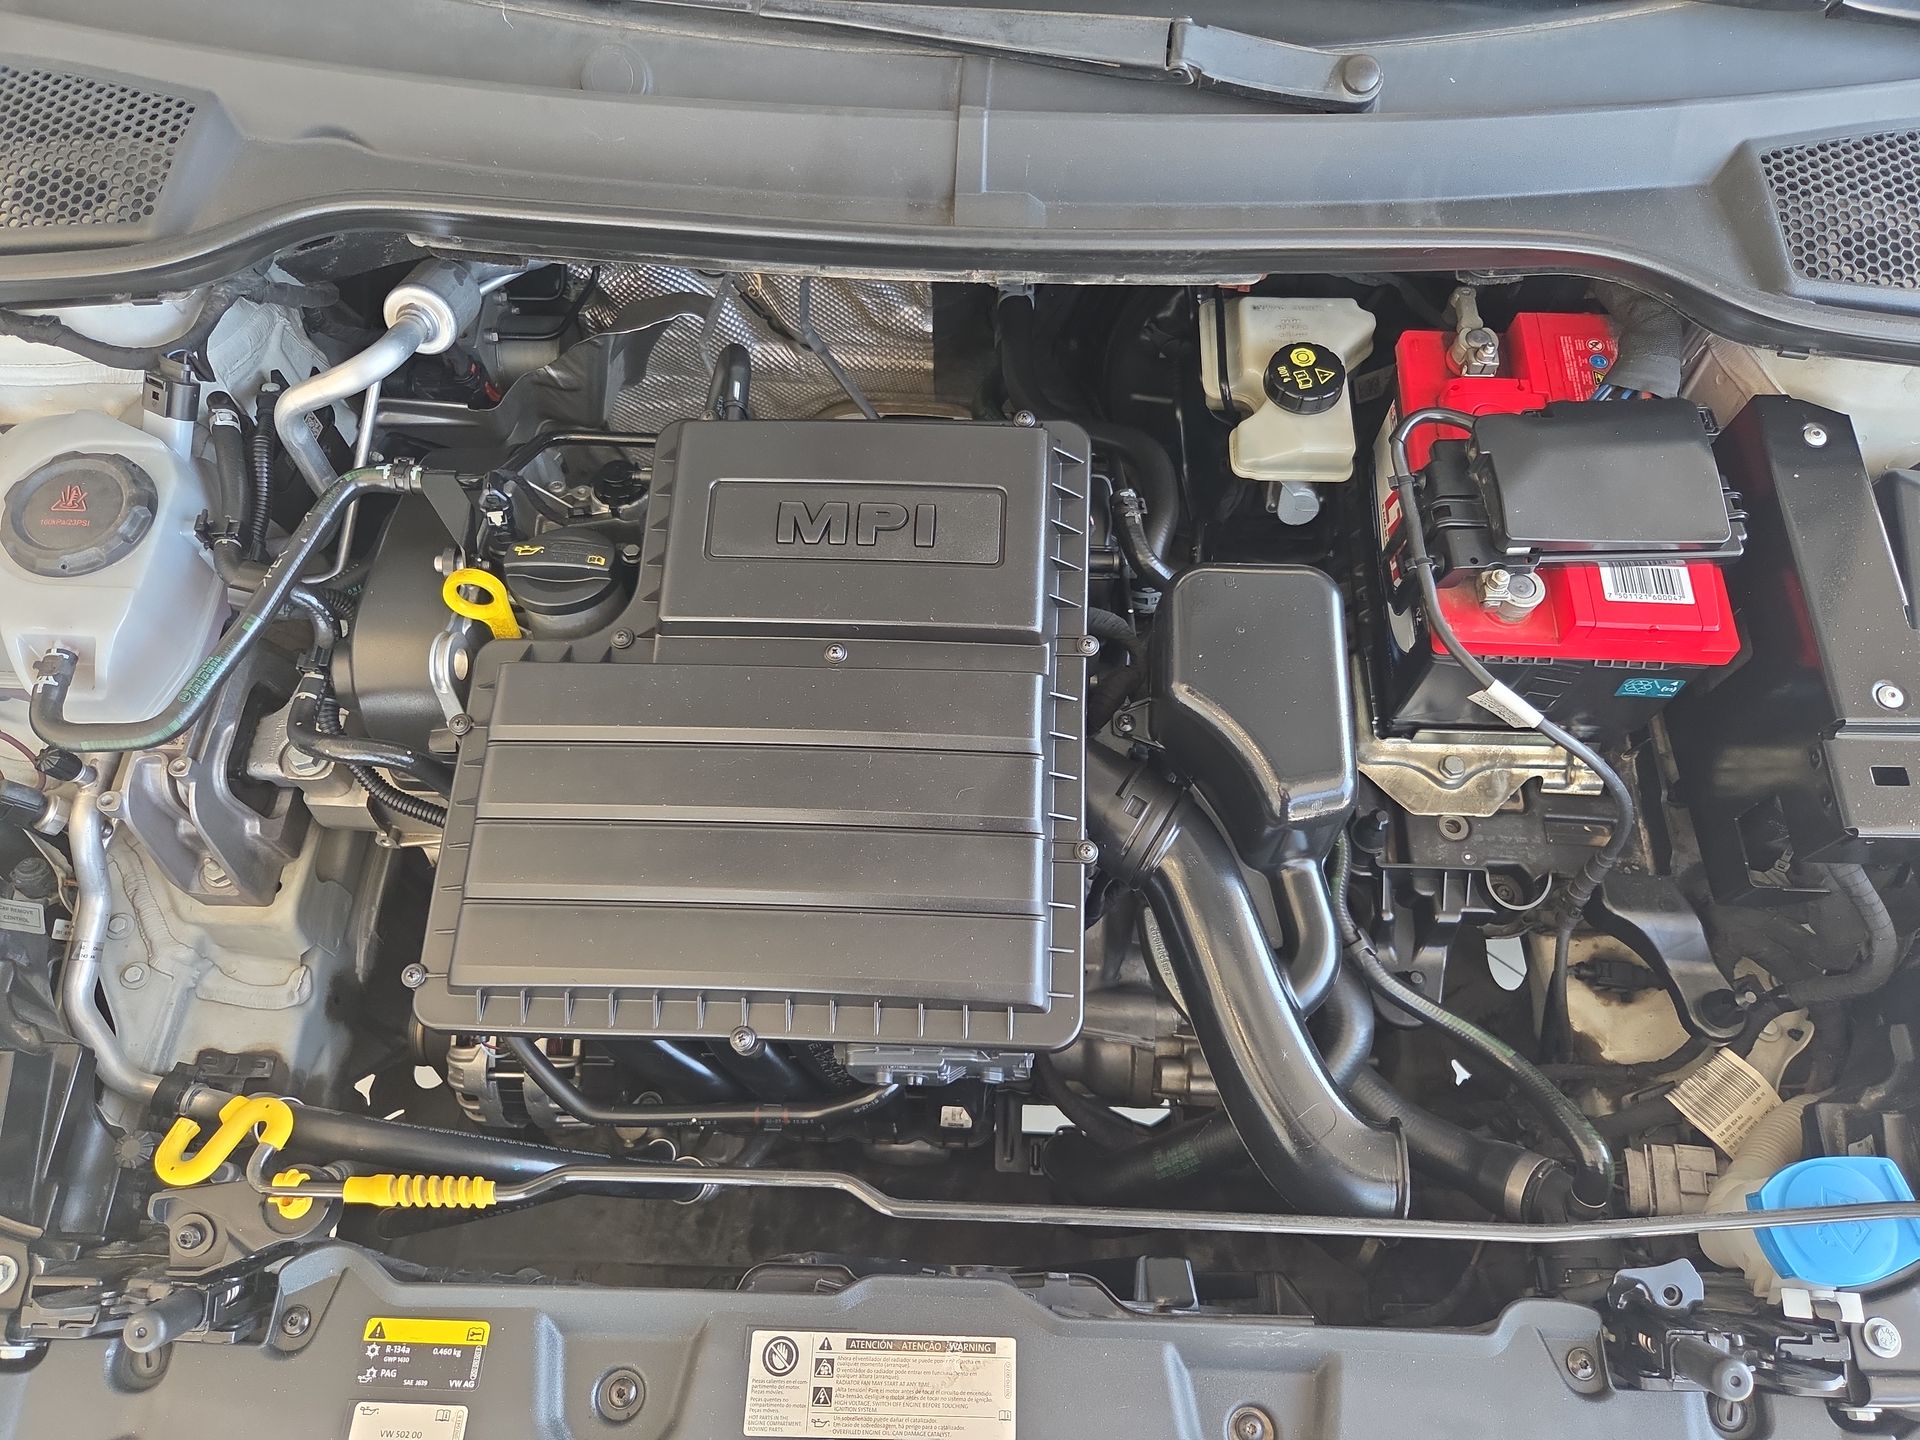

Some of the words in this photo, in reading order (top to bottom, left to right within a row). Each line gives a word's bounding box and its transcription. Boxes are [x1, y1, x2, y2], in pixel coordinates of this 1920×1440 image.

[1278, 366, 1290, 377] DOT
[777, 501, 937, 548] MPI
[386, 1345, 410, 1354] R-134a
[453, 1348, 462, 1357] kg
[850, 1339, 893, 1349] ATENCIÓN
[902, 1340, 941, 1352] ATENÇÃO
[950, 1342, 991, 1352] WARNING
